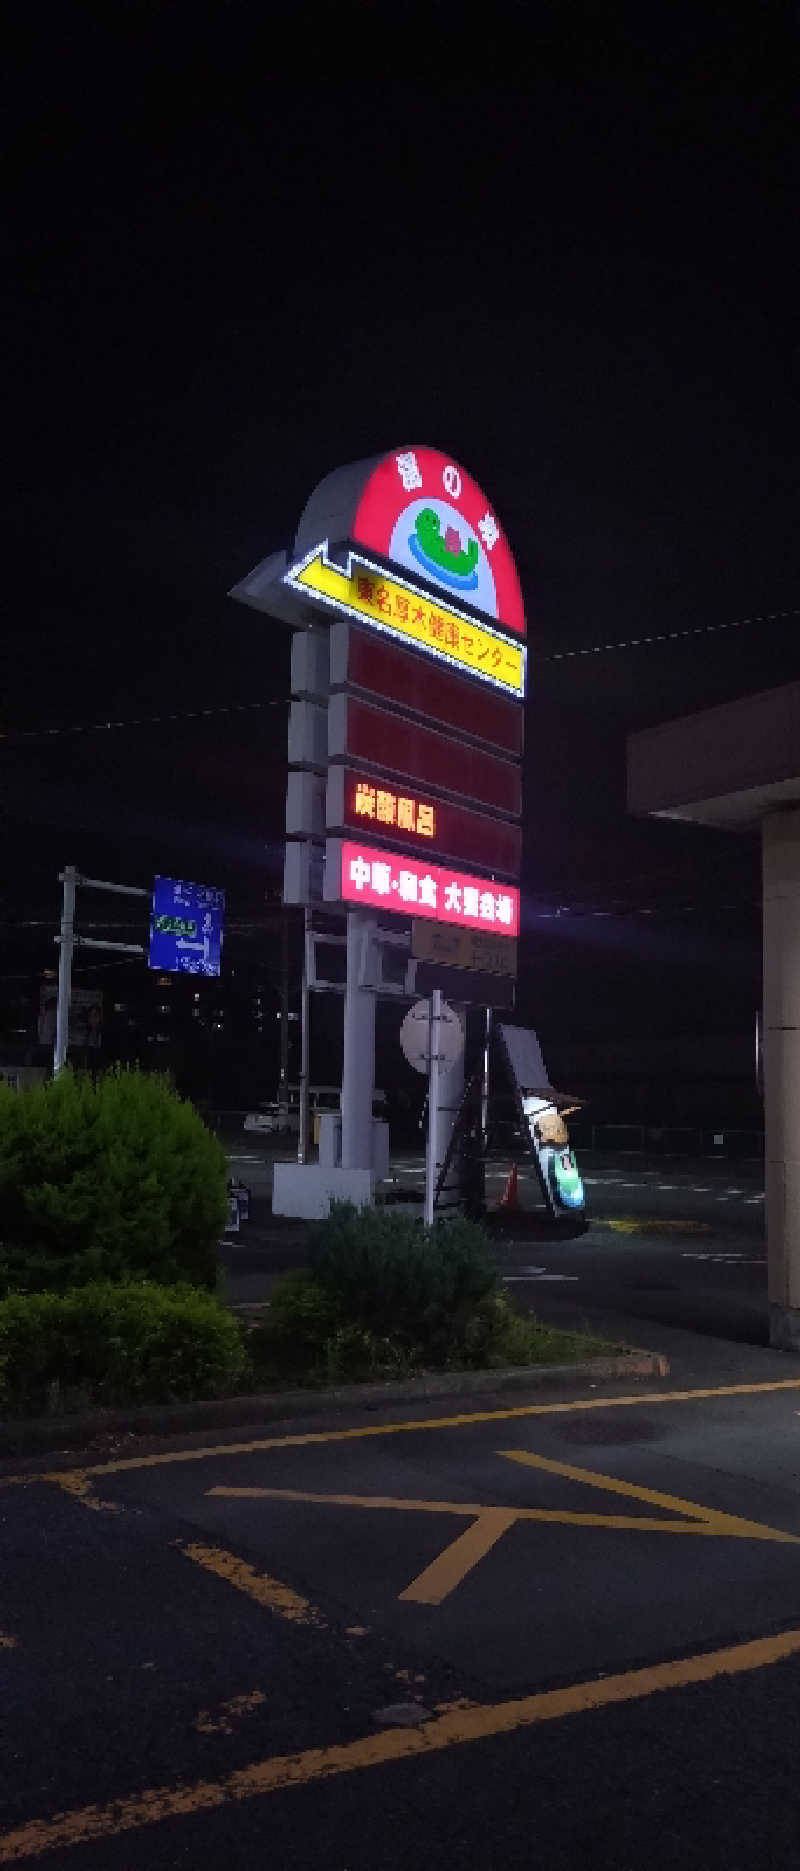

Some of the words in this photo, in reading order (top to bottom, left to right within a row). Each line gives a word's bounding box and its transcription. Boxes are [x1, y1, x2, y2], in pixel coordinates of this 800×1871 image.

[358, 577, 518, 669] 東名厚木健康センター
